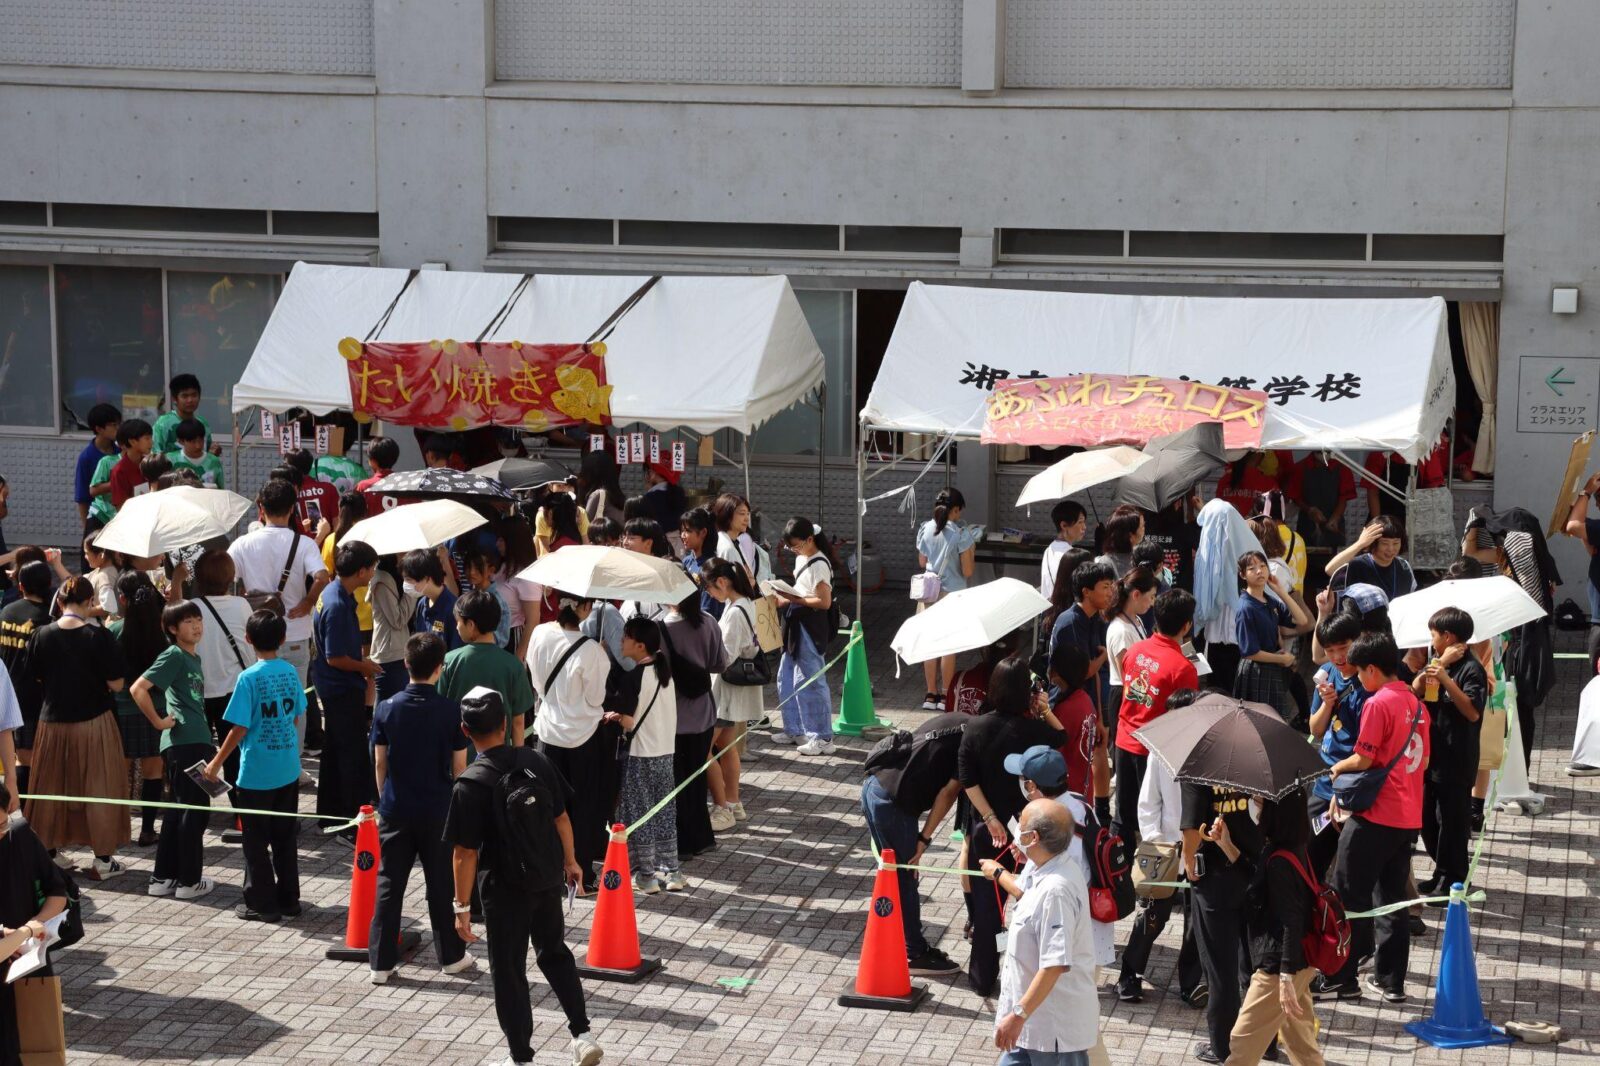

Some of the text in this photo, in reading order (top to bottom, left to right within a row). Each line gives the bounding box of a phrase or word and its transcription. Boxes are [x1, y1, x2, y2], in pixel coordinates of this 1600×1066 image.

[354, 358, 547, 407] たい焼き
[1530, 405, 1586, 415] クラスエリア
[1530, 415, 1586, 425] エントランス
[263, 411, 271, 432] チーズ
[282, 427, 290, 449] あんこ
[318, 427, 327, 449] あんこ
[618, 437, 626, 459] あんこ
[633, 435, 641, 455] チーズ
[674, 443, 682, 465] あんこ
[296, 486, 324, 498] nato
[1403, 731, 1424, 774] 9
